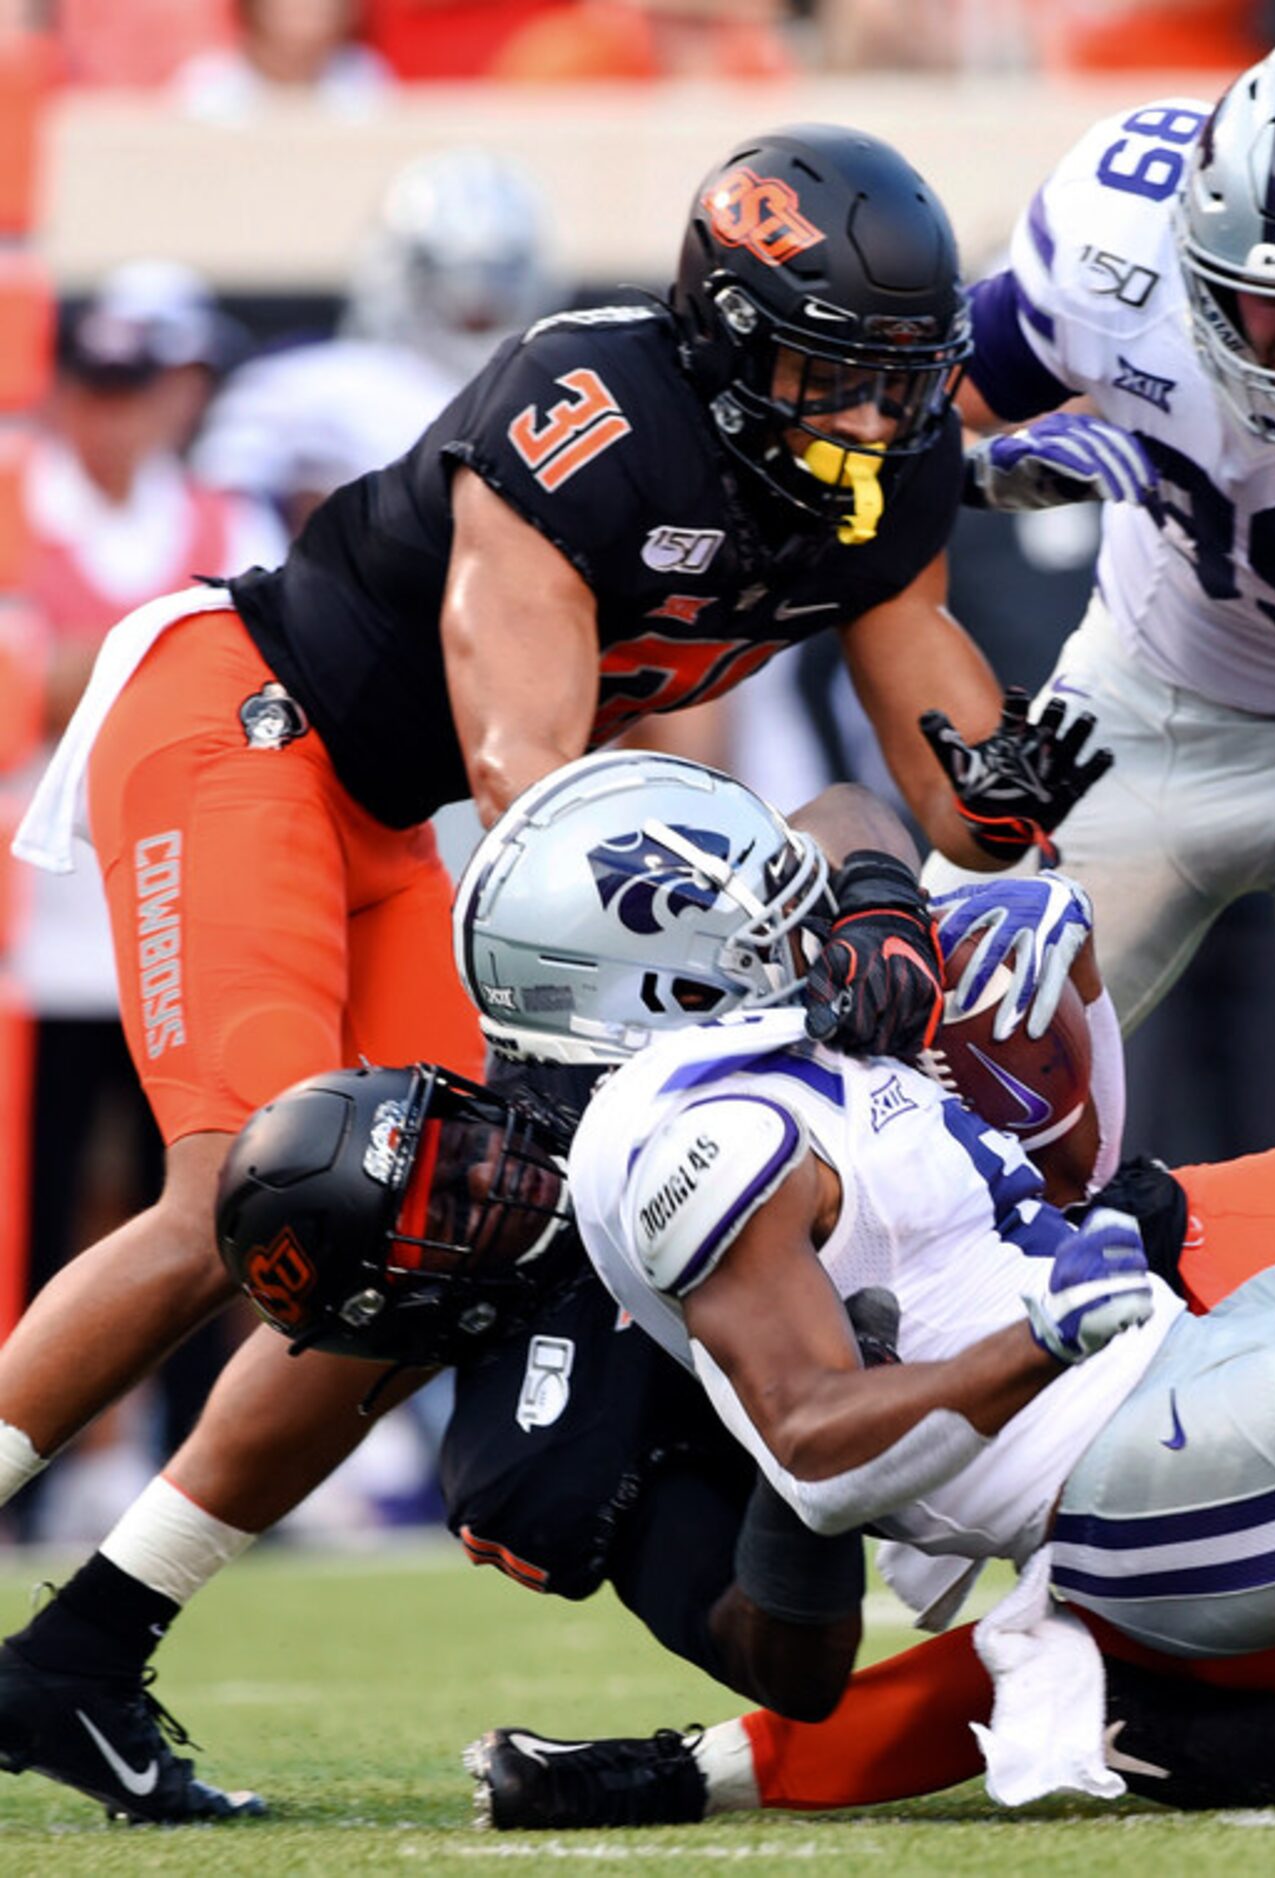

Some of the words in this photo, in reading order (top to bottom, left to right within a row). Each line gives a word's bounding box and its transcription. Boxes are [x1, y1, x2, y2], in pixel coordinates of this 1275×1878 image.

[1079, 244, 1161, 308] 150
[507, 367, 632, 493] 31
[134, 829, 187, 1060] COWBOYS
[640, 1134, 720, 1241] DOUGLAS
[516, 1334, 575, 1433] 150
